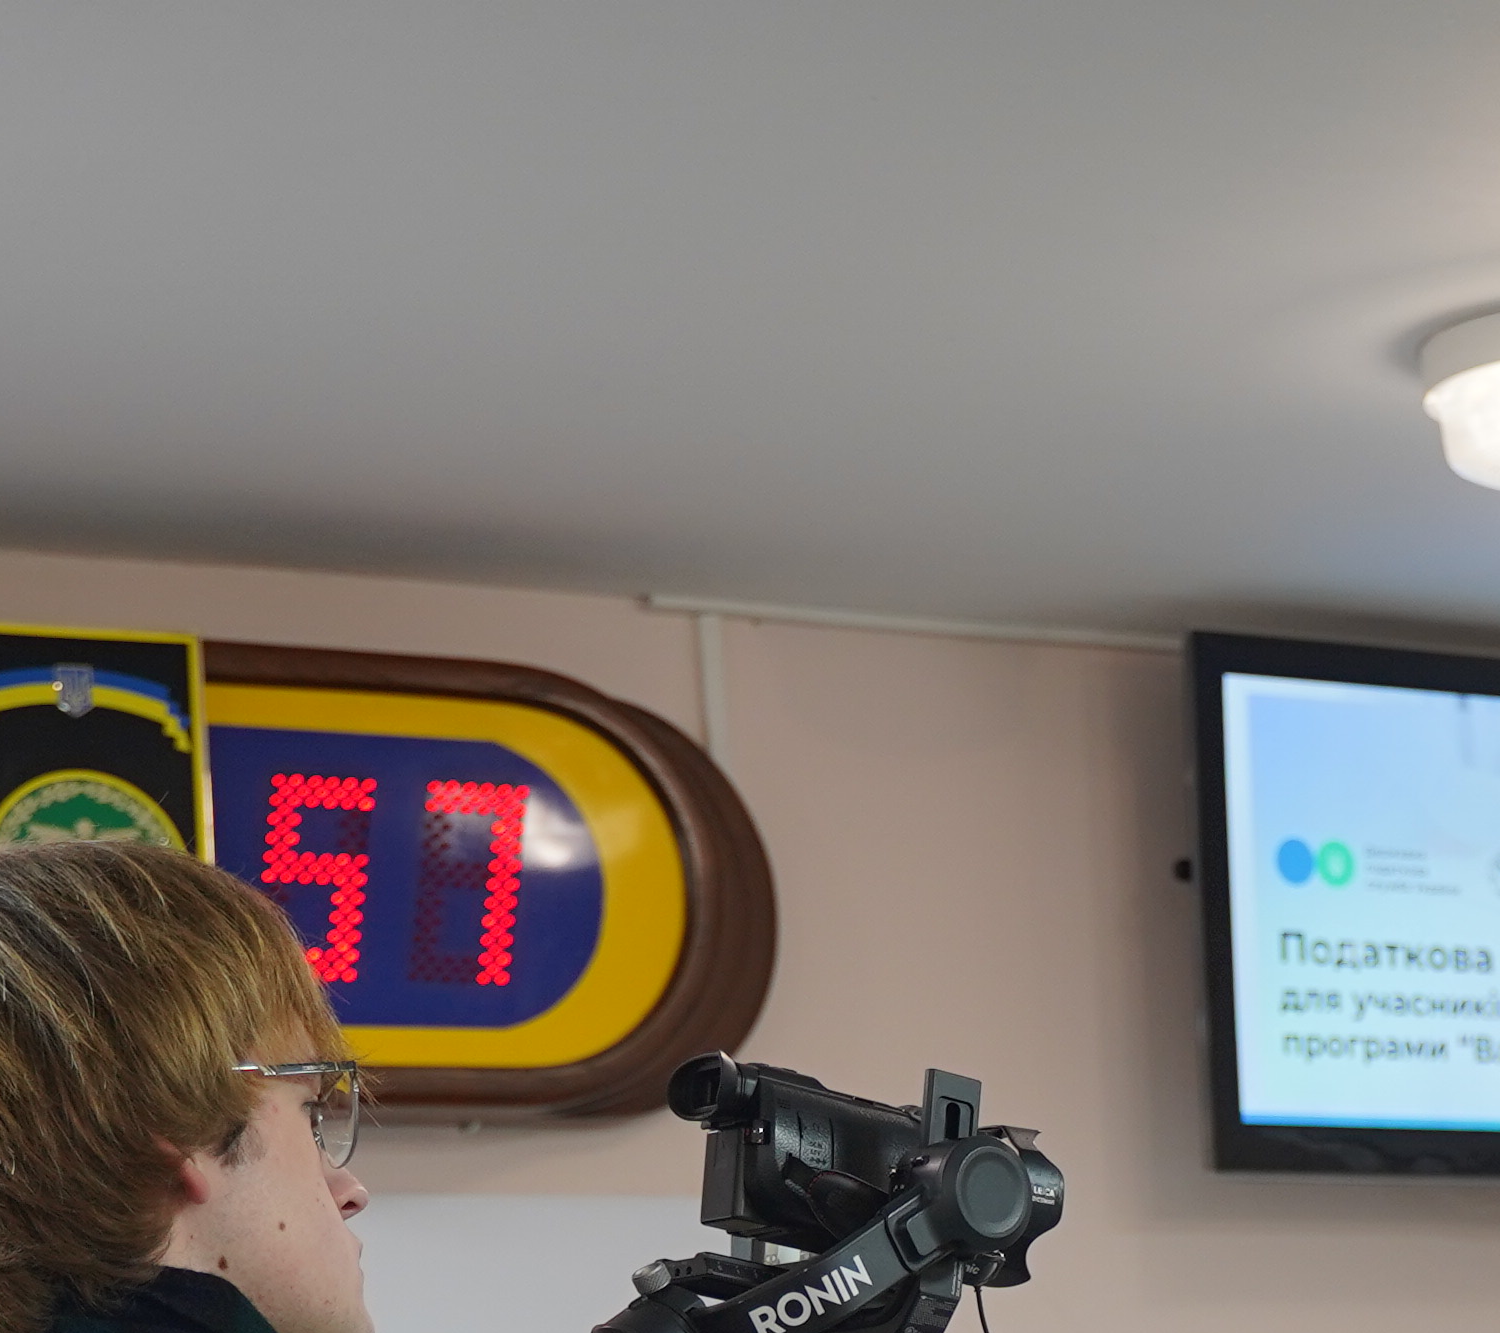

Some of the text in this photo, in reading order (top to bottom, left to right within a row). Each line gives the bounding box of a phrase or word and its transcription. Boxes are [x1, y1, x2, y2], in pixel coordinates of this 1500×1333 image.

[260, 772, 530, 987] 57
[1277, 929, 1494, 976] Податкова
[1279, 987, 1343, 1015] для
[1282, 1031, 1449, 1064] програми
